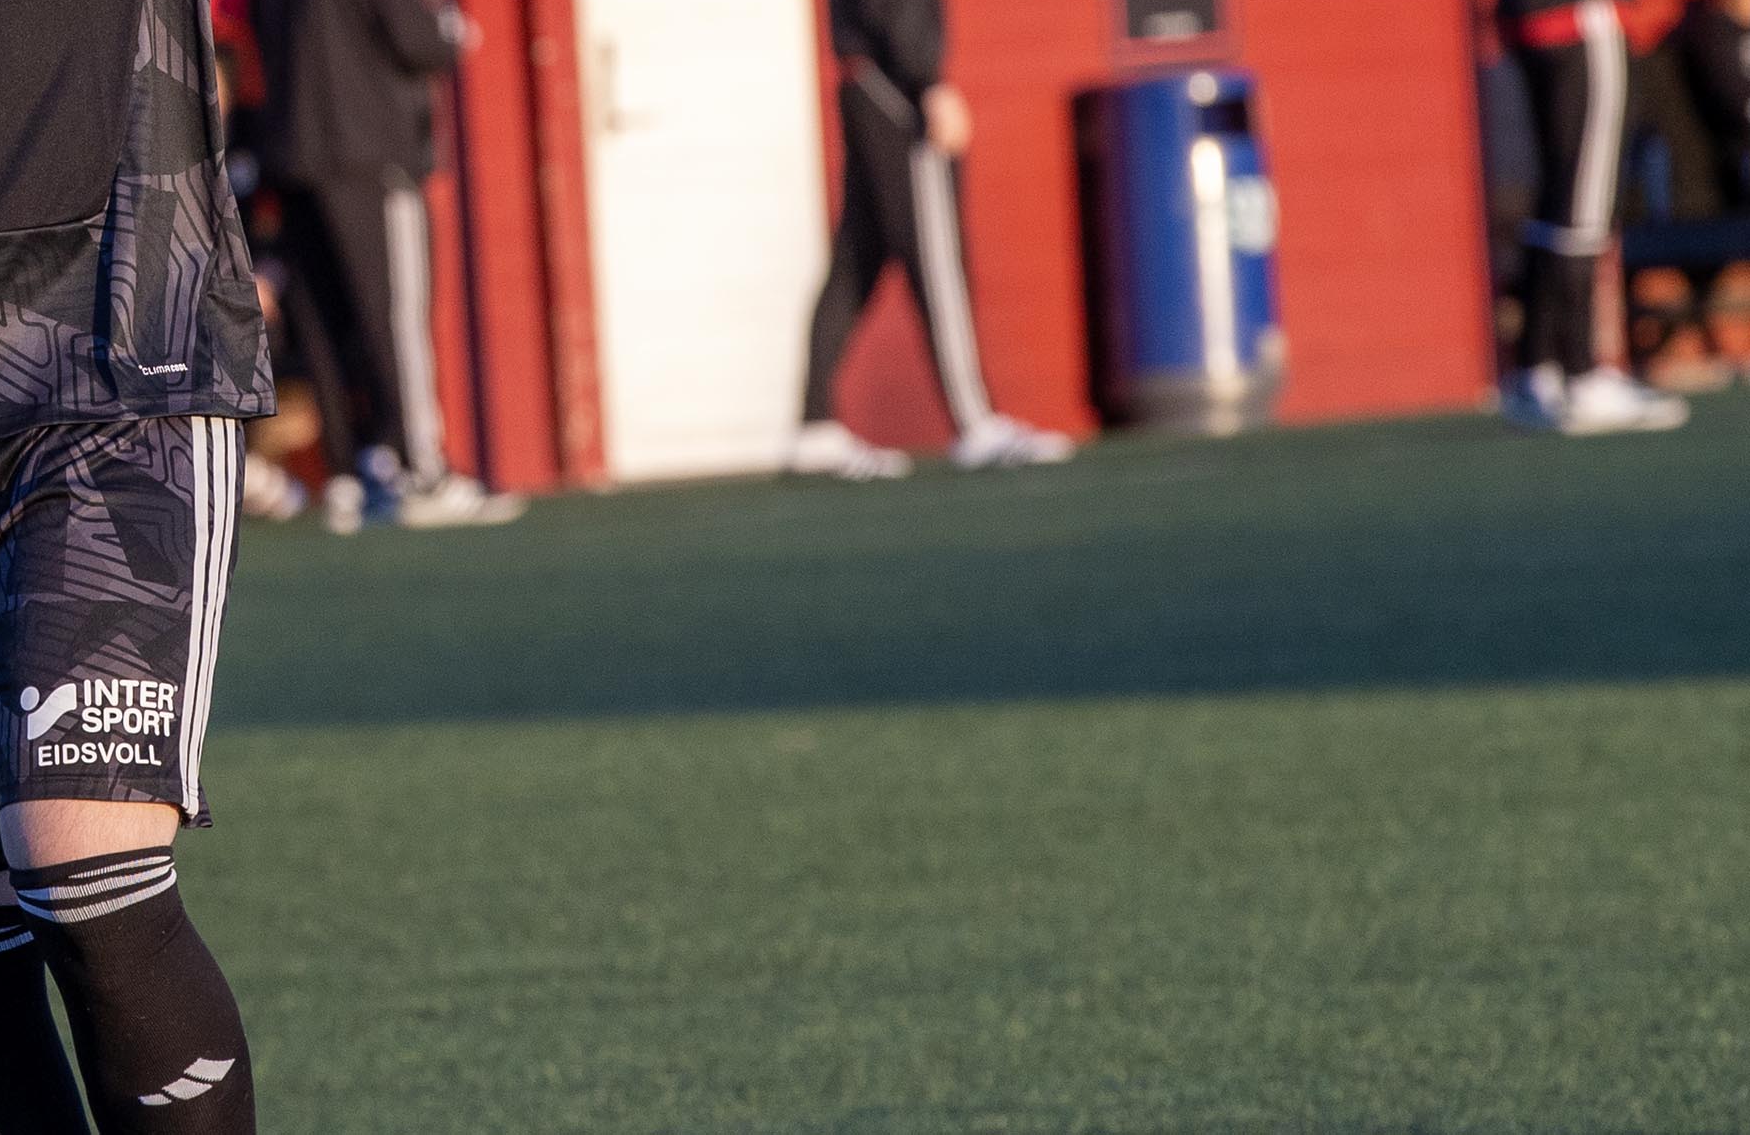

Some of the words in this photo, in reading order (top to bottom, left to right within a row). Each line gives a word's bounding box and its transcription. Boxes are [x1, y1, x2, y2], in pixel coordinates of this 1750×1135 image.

[84, 679, 175, 711] INTER
[82, 707, 175, 737] SPORT
[38, 742, 162, 767] EIDSVOLL
